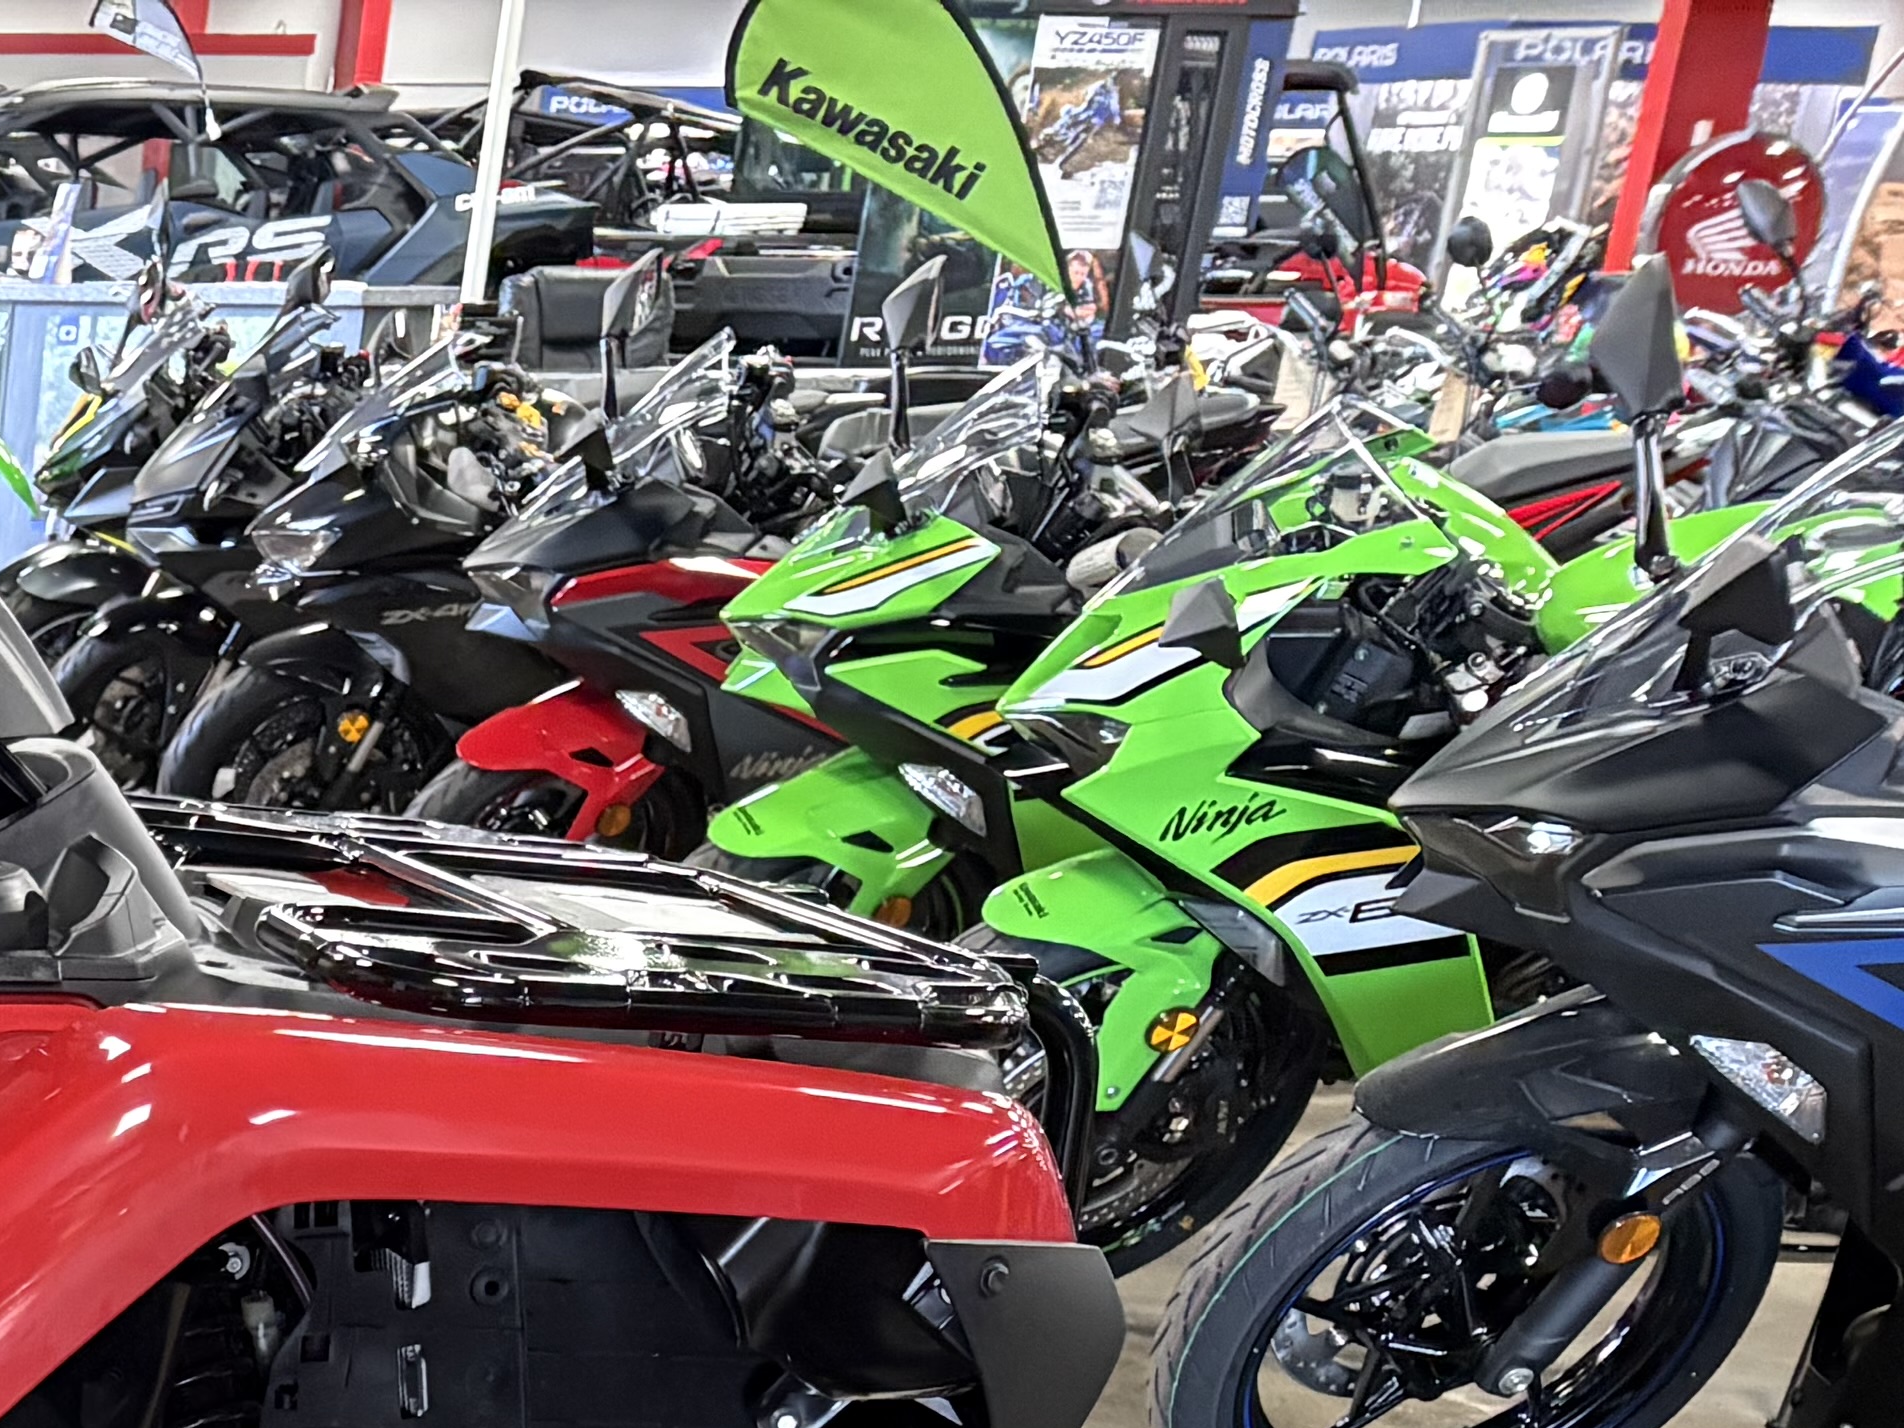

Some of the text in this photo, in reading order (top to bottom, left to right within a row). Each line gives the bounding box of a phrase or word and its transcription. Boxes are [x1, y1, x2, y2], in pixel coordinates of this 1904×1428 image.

[1055, 30, 1145, 47] YZ450F
[757, 57, 986, 201] Kawasaki
[1681, 258, 1783, 276] HONDA
[1158, 791, 1287, 844] Ninja
